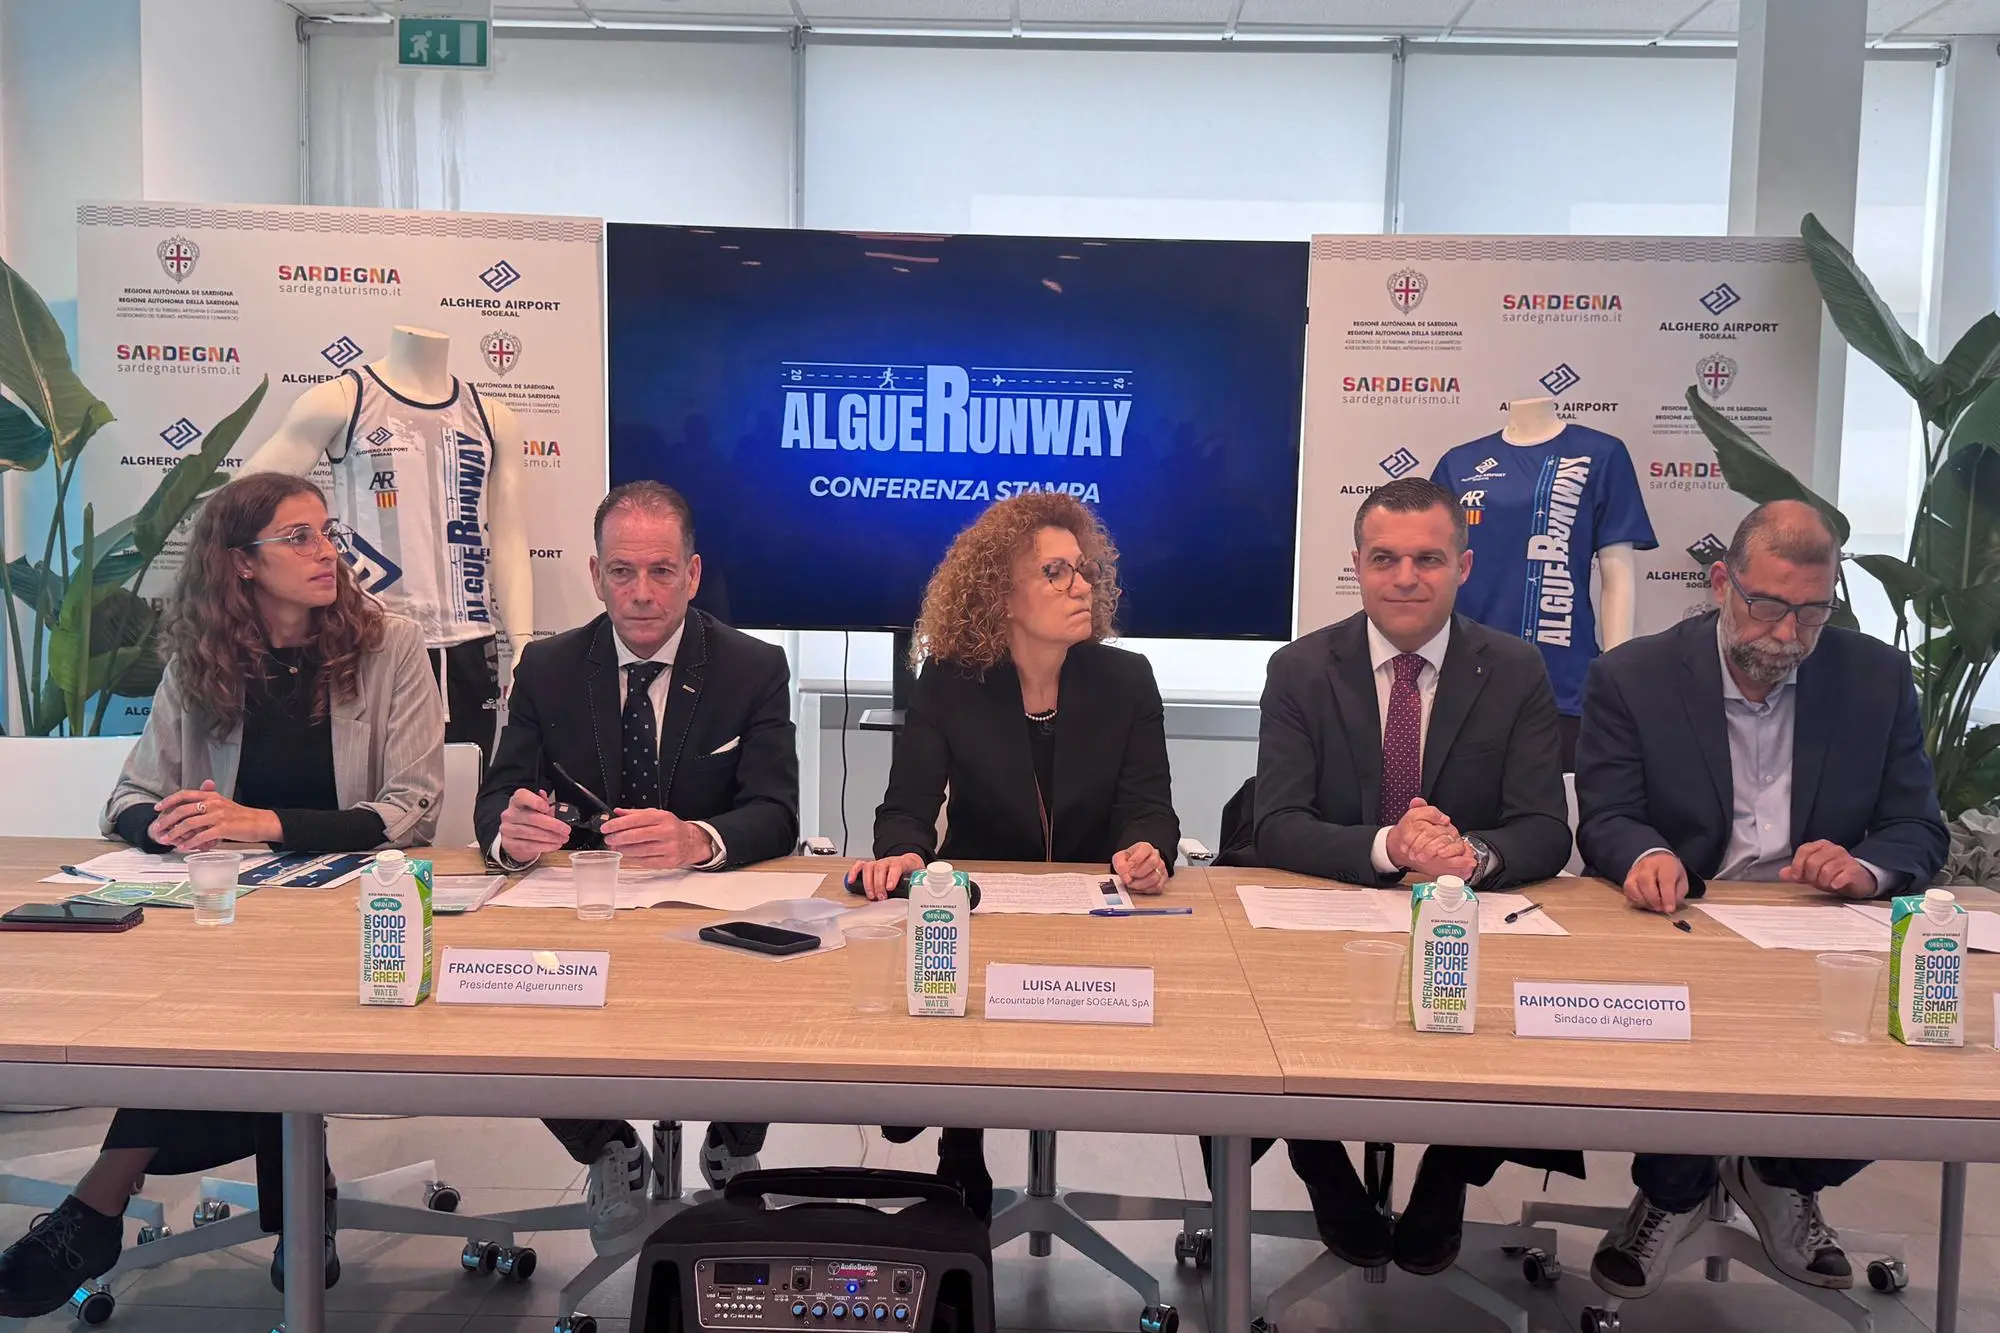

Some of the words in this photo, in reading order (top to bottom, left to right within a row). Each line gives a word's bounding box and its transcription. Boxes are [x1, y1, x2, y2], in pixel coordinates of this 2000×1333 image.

[278, 265, 401, 284] SARDEGNA
[279, 284, 401, 296] sardegnaturismo.it
[440, 298, 501, 309] ALGHERO
[505, 300, 560, 311] AIRPORT
[1504, 295, 1622, 310] SARDEGNA
[1503, 312, 1622, 324] sardegnaturismo.it
[1659, 322, 1719, 332] ALGHERO
[1723, 323, 1779, 332] AIRPORT
[117, 344, 240, 363] SARDEGNA
[117, 363, 240, 375] sardegnaturismo.it
[1343, 377, 1460, 392] SARDEGNA
[1342, 394, 1460, 406] sardegnaturismo.it
[780, 365, 1132, 457] ALGUERUNWAY
[1563, 403, 1618, 412] AIRPORT
[1650, 462, 1721, 477] SARDE
[809, 476, 990, 501] CONFERENZA
[530, 550, 563, 558] PORT
[1646, 571, 1706, 580] ALGHERO
[373, 915, 406, 929] GOOD
[373, 929, 406, 943] PURE
[925, 926, 957, 940] GOOD
[372, 944, 405, 958] COOL
[925, 941, 957, 955] PURE
[1435, 941, 1468, 956] GOOD
[373, 960, 406, 970] SMART
[924, 956, 956, 969] COOL
[1435, 956, 1468, 971] PURE
[1927, 955, 1960, 969] GOOD
[448, 963, 533, 975] FRANCESCO
[373, 971, 406, 983] GREEN
[924, 971, 956, 981] SMART
[1434, 971, 1467, 986] COOL
[1926, 970, 1959, 984] PURE
[459, 980, 514, 991] Presidente
[515, 981, 583, 992] Alguerunners
[924, 982, 956, 994] GREEN
[1023, 980, 1062, 991] LUISA
[1064, 981, 1115, 992] ALIVESI
[1434, 986, 1467, 998] SMART
[1926, 985, 1958, 999] COOL
[989, 996, 1045, 1005] Accountable
[1046, 997, 1085, 1008] Manager
[1086, 998, 1130, 1007] SOGEAAL
[1132, 999, 1149, 1008] SpA
[1433, 998, 1466, 1010] GREEN
[1520, 996, 1600, 1008] RAIMONDO
[1602, 998, 1686, 1011] CACCIOTTO
[1925, 1000, 1958, 1012] SMART
[1433, 1015, 1458, 1024] WATER
[1554, 1014, 1598, 1024] Sindaco
[1600, 1014, 1610, 1024] di
[1612, 1015, 1652, 1028] Alghero
[1924, 1012, 1957, 1024] GREEN
[1924, 1029, 1949, 1037] WATER
